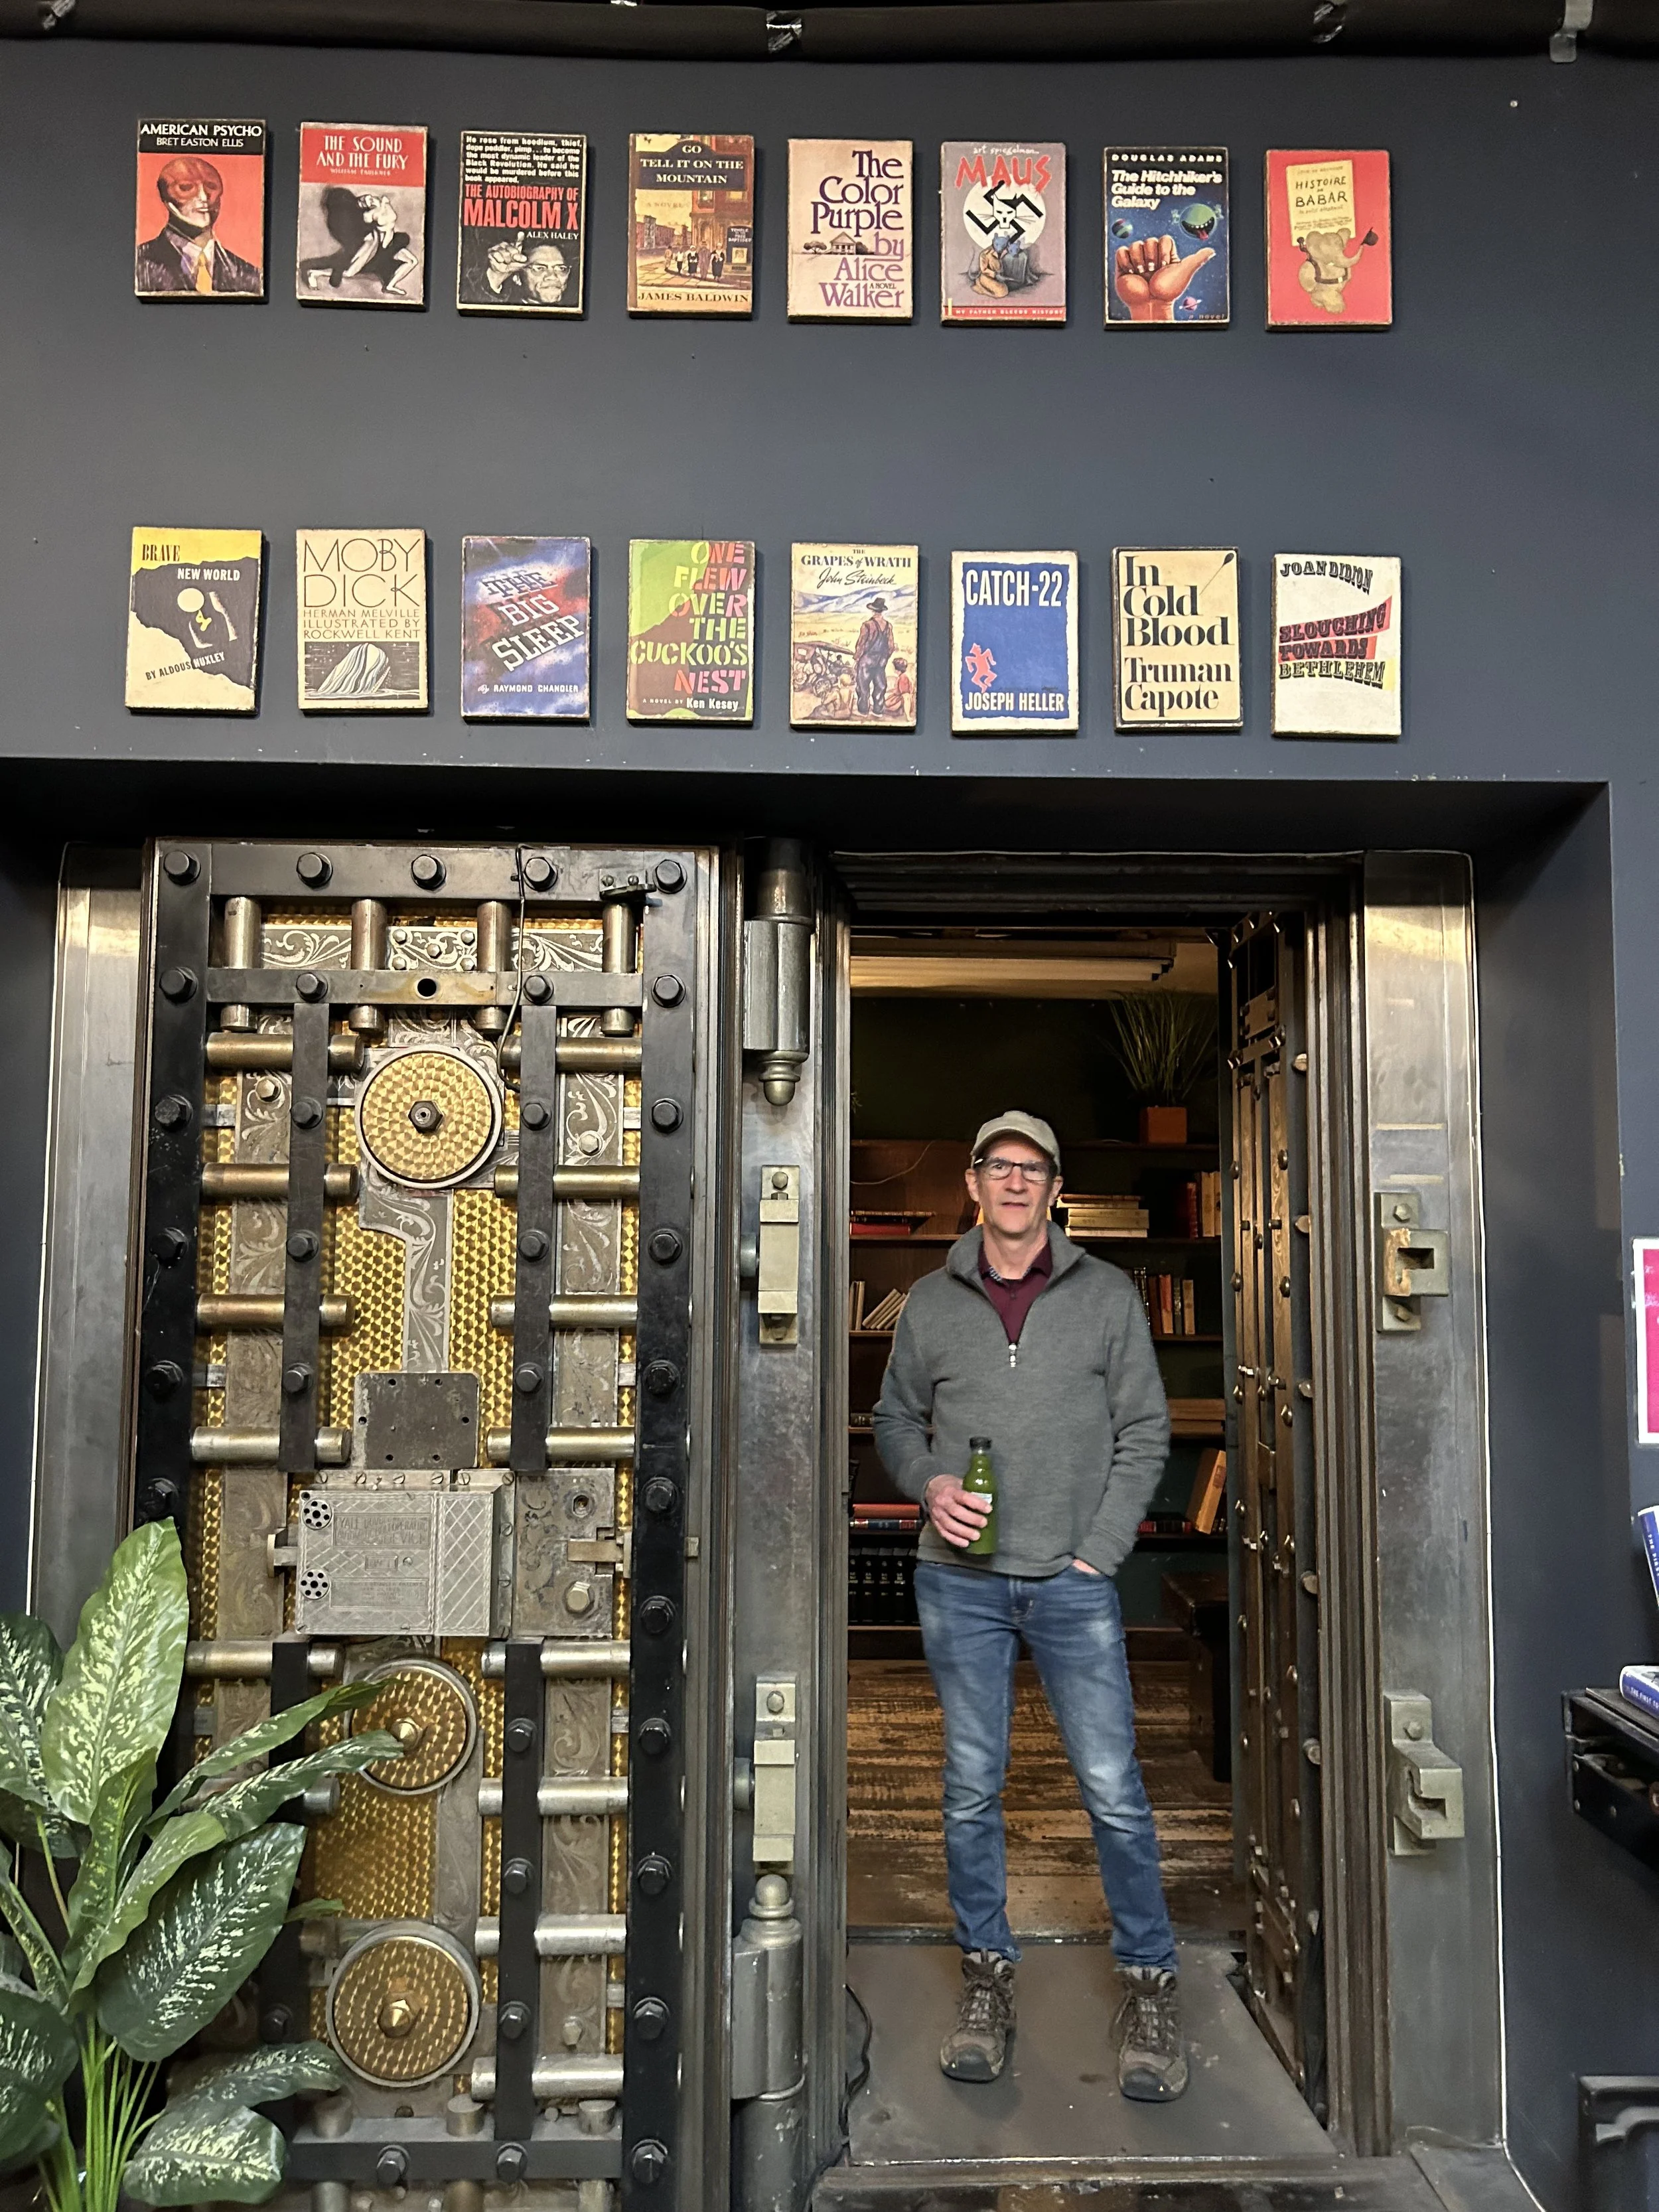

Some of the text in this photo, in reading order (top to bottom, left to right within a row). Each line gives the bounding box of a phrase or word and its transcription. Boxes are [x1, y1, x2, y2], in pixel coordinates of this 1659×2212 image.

[140, 124, 262, 136] AMERICAN PSYCHO
[181, 138, 218, 147] EASTON
[324, 135, 402, 153] THE SOUND
[317, 151, 409, 170] AND THE FURY
[640, 159, 673, 167] TELL
[852, 150, 904, 179] The
[656, 175, 727, 183] MOUNTAIN
[955, 155, 1052, 193] MAUS
[1112, 170, 1222, 183] The Hitchhiker's
[1295, 176, 1346, 189] HISTOIRE
[465, 184, 579, 201] THE AUTOBIOGRAPHY OF
[820, 175, 904, 204] Color
[1112, 183, 1196, 196] Guide to the
[1296, 191, 1347, 207] BABAR
[464, 198, 578, 230] MALCOLM X
[1112, 196, 1161, 210] Galaxy
[811, 200, 904, 237] Purple
[863, 231, 904, 261] by
[834, 258, 904, 281] Alice
[687, 293, 749, 303] BALDWIN
[819, 282, 904, 308] Walker
[142, 544, 180, 561] BRAVE
[303, 538, 420, 572] MOBY
[691, 542, 745, 564] ONE
[801, 555, 911, 568] GRAPES of WRATH
[178, 568, 240, 581] NEW WORLD
[674, 565, 747, 591] FLEW
[817, 567, 897, 589] John Steinbeck
[1123, 555, 1163, 586] In
[1280, 560, 1374, 595] JOAN DIDION
[304, 573, 419, 607] DICK
[482, 570, 558, 599] THE
[966, 569, 1062, 607] CATCH-22
[498, 594, 559, 626] BIG
[669, 593, 747, 617] OVER
[1123, 585, 1203, 617] Cold
[303, 619, 419, 628] ILLUSTRATED BY
[304, 630, 420, 639] ROCKWELL KENT
[689, 617, 747, 641] THE
[1123, 616, 1235, 647] Blood
[1279, 603, 1386, 643] SLOUCHING
[492, 615, 584, 672] SLEEP
[630, 640, 748, 666] CUCKOO'S
[1279, 638, 1368, 661] TOWARDS
[145, 652, 225, 680] BY ALDOUS HUXLEY
[1125, 657, 1234, 683] Truman
[1279, 660, 1386, 690] BETHLEHEM
[674, 669, 747, 694] NEST
[686, 698, 705, 708] Ken
[709, 698, 739, 711] Kesey
[965, 692, 1064, 711] JOSEPH HELLER
[1124, 684, 1219, 717] Capote
[1640, 1692, 1651, 1704] FIRST
